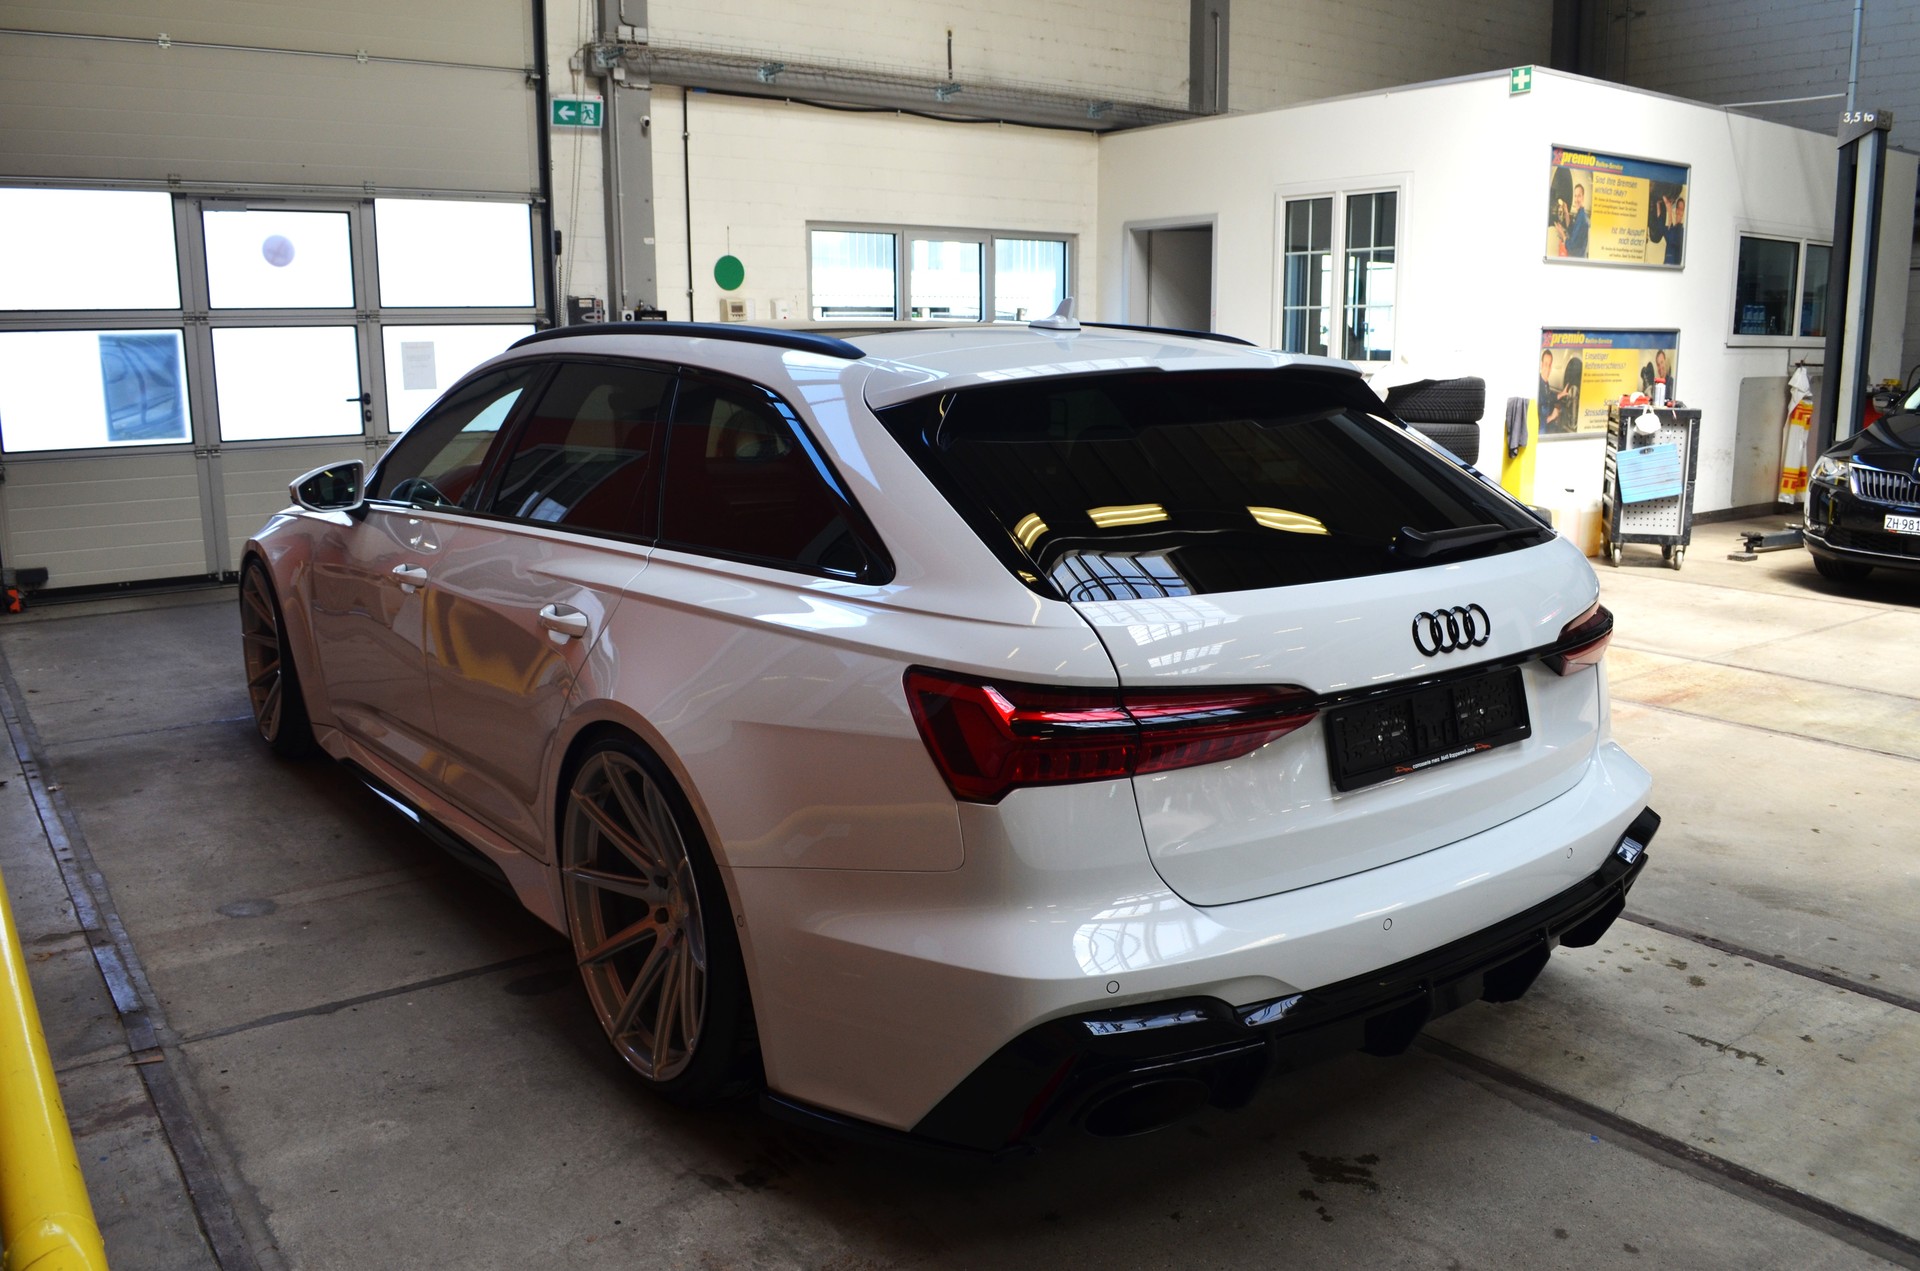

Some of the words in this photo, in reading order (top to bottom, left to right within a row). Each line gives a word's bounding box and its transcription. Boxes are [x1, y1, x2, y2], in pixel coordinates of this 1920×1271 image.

[1843, 111, 1861, 124] 3,5
[1863, 112, 1875, 122] to
[1561, 151, 1596, 167] premio
[1551, 331, 1585, 347] premio
